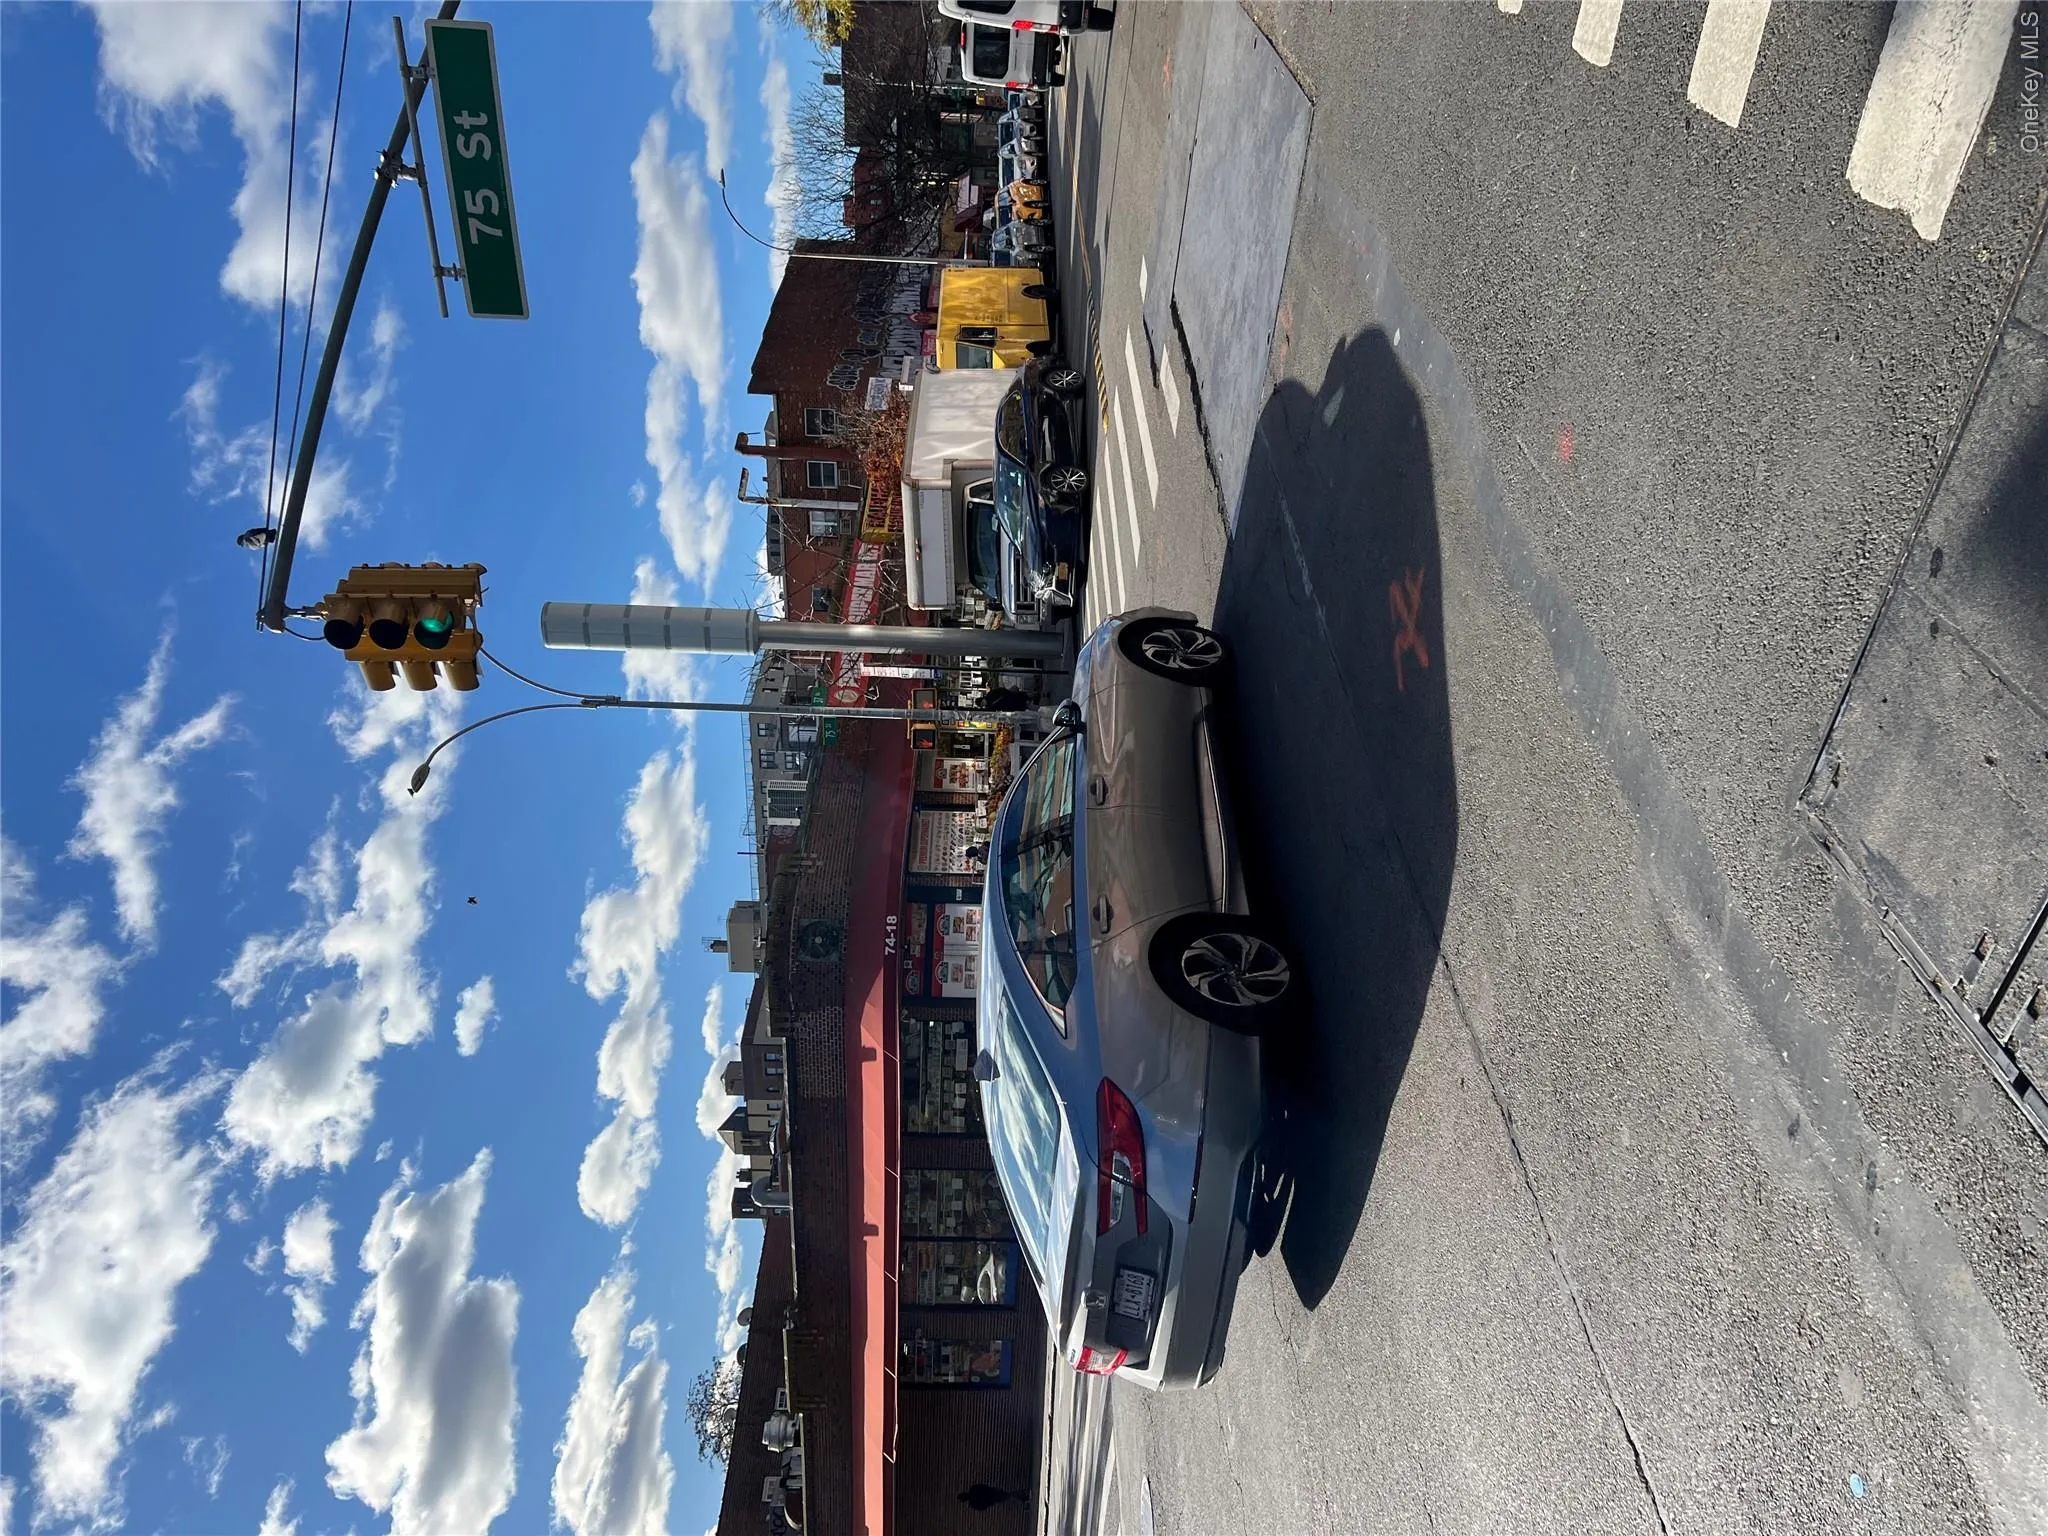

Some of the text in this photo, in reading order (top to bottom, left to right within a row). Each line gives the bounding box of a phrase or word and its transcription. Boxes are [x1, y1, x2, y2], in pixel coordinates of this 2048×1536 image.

[453, 110, 503, 245] 75 St
[825, 730, 836, 738] 75
[884, 915, 898, 956] 74-18
